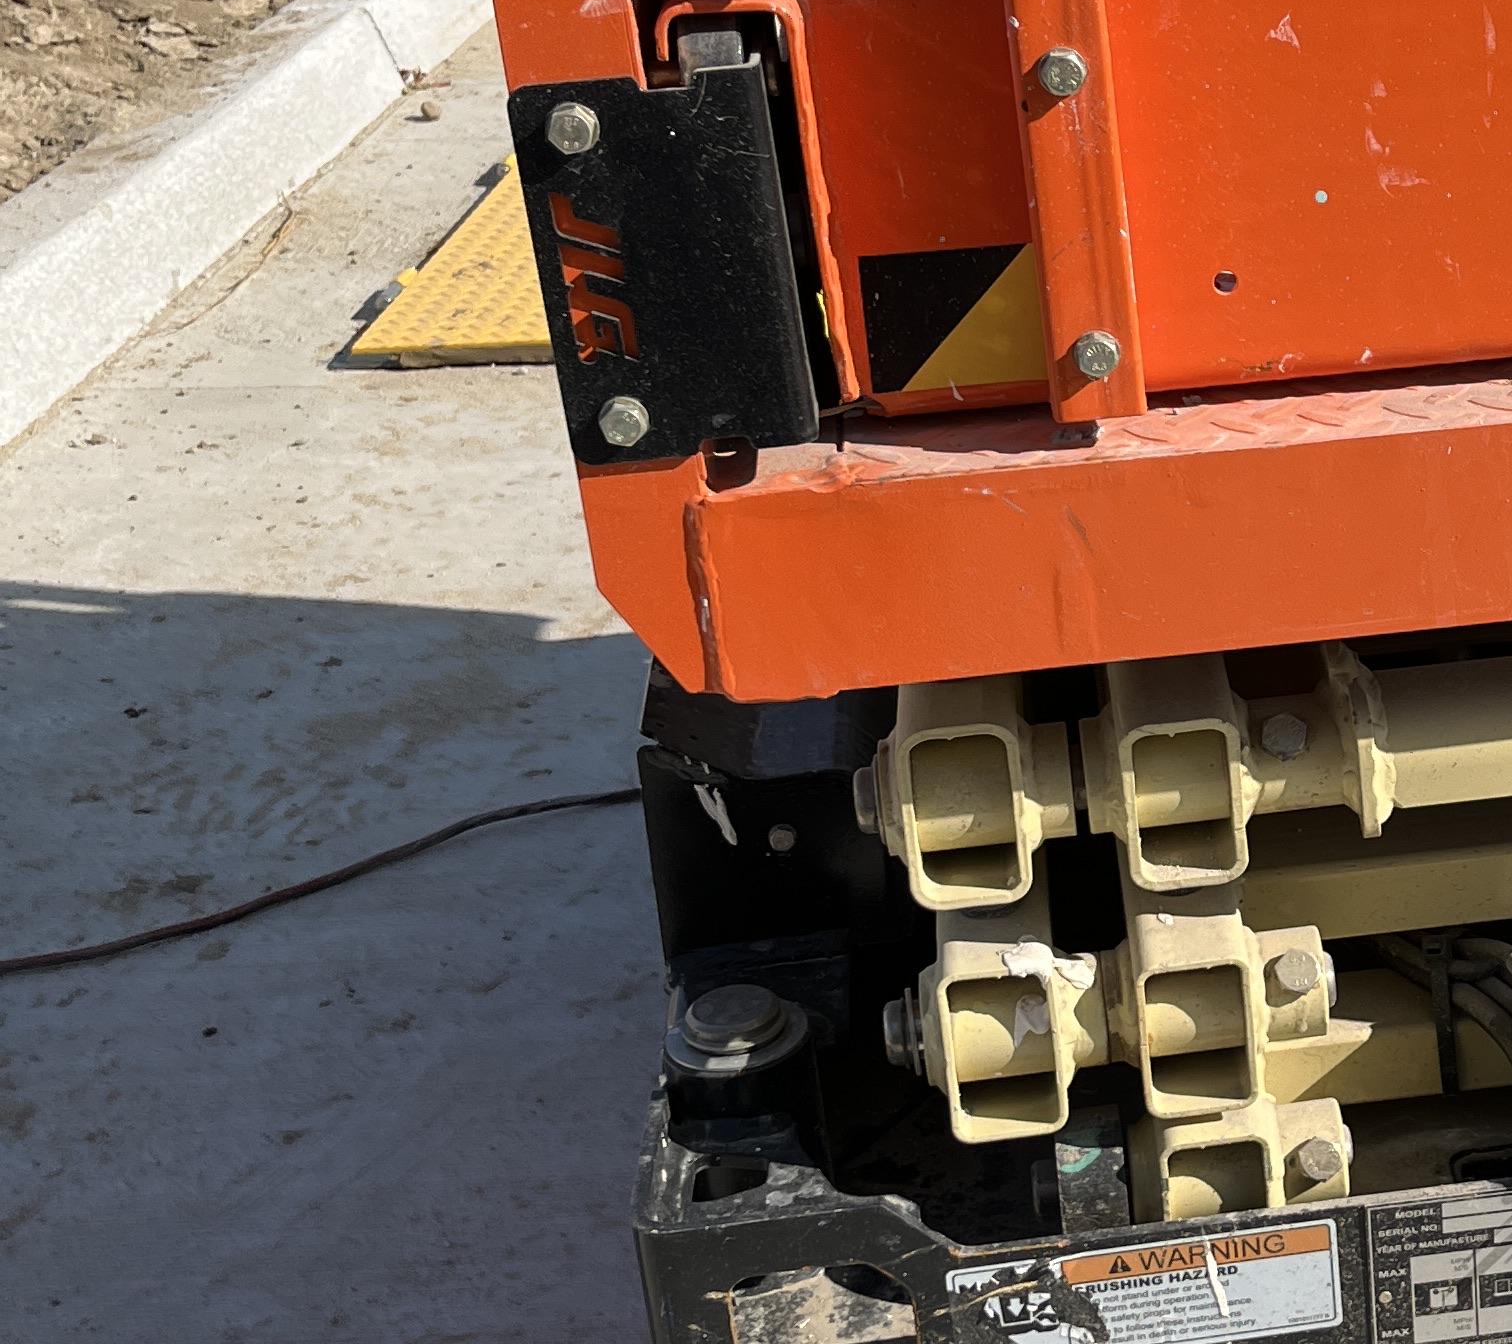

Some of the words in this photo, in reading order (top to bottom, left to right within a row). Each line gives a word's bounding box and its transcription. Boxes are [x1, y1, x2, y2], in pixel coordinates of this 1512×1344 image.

[547, 191, 641, 366] JLG
[1377, 1225, 1418, 1238] SERIAL
[1138, 1232, 1285, 1272] WARNING
[1376, 1243, 1402, 1254] YEAR
[1403, 1241, 1417, 1251] OF
[1418, 1232, 1489, 1249] MANUFACTURE
[1377, 1267, 1407, 1279] MAX
[1103, 1295, 1118, 1303] not
[1121, 1290, 1148, 1300] stand
[1151, 1286, 1179, 1296] under
[1129, 1298, 1160, 1311] during
[1110, 1311, 1140, 1324] safety
[1142, 1308, 1170, 1319] props
[1173, 1304, 1186, 1313] for
[1113, 1326, 1123, 1334] to
[1125, 1321, 1154, 1332] follow
[1156, 1316, 1184, 1328] these
[1136, 1332, 1145, 1340] in
[1148, 1328, 1176, 1338] death
[1191, 1321, 1227, 1332] serious
[1380, 1327, 1410, 1339] MAX
